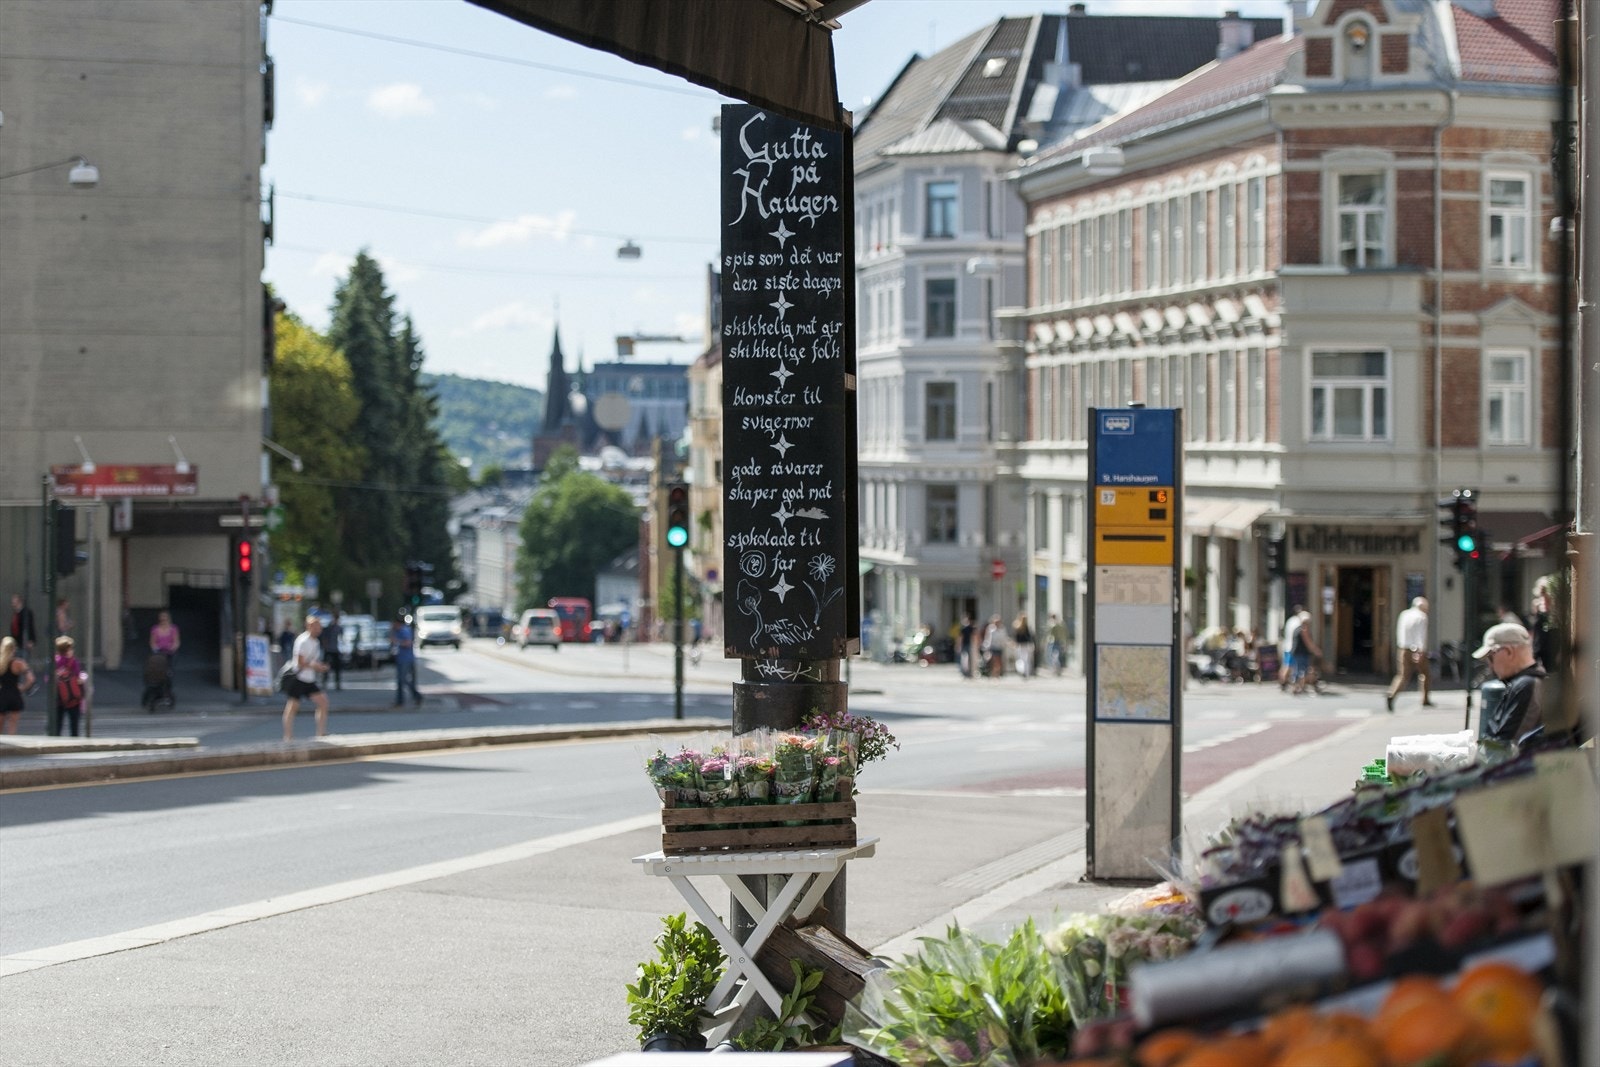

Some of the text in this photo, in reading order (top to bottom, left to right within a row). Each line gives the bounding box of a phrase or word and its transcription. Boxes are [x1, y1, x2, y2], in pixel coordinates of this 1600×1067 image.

[739, 111, 828, 178] Gutta
[789, 160, 822, 197] på
[728, 167, 839, 229] Haugen
[725, 245, 842, 273] spis som det var
[732, 269, 842, 300] den siste dagen
[723, 314, 843, 344] skikkelig mat gir
[728, 338, 840, 366] skikkelige folk
[732, 386, 823, 406] blomster til
[741, 415, 814, 439] svigermor
[730, 457, 824, 484] gode råvarer
[1113, 474, 1159, 484] Hanshaugen
[728, 480, 833, 510] skaper god mat
[1103, 492, 1115, 504] 37
[727, 526, 821, 553] sjokolade til
[770, 549, 797, 578] far
